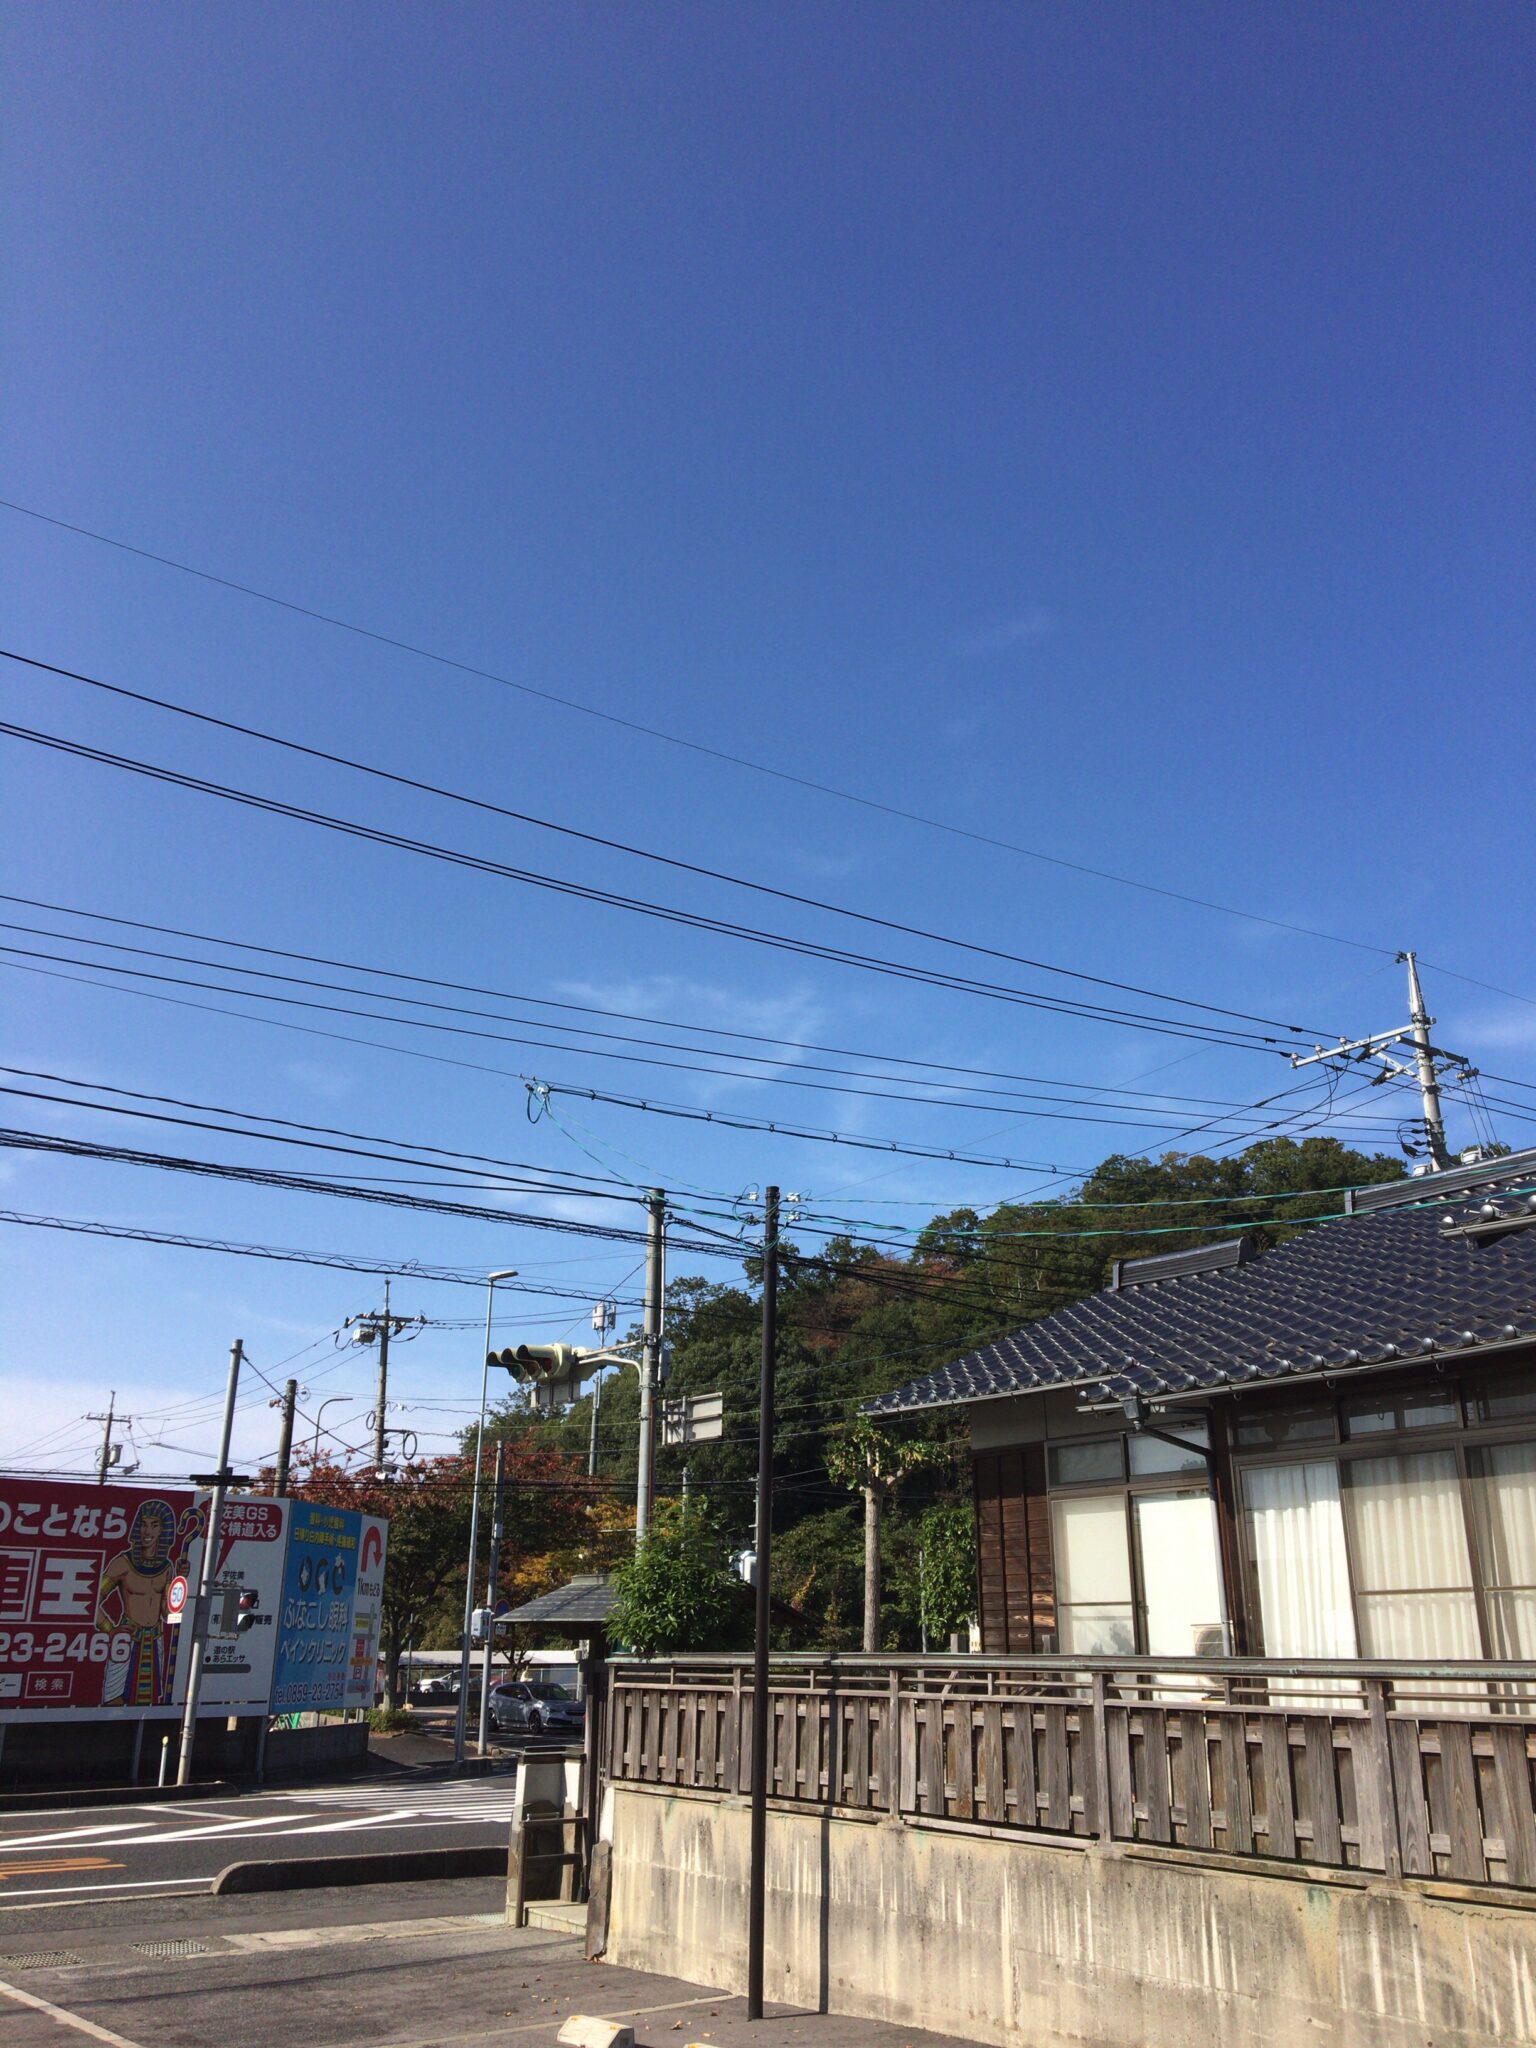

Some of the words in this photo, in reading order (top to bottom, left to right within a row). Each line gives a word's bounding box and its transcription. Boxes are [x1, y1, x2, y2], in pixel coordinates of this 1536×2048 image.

[207, 1503, 268, 1520] 佐美GS
[172, 1586, 183, 1602] 50
[213, 1645, 236, 1655] 道の駅
[280, 1638, 347, 1666] ペインクリニック
[212, 1655, 246, 1664] あらエッサ
[34, 1678, 65, 1691] 検索
